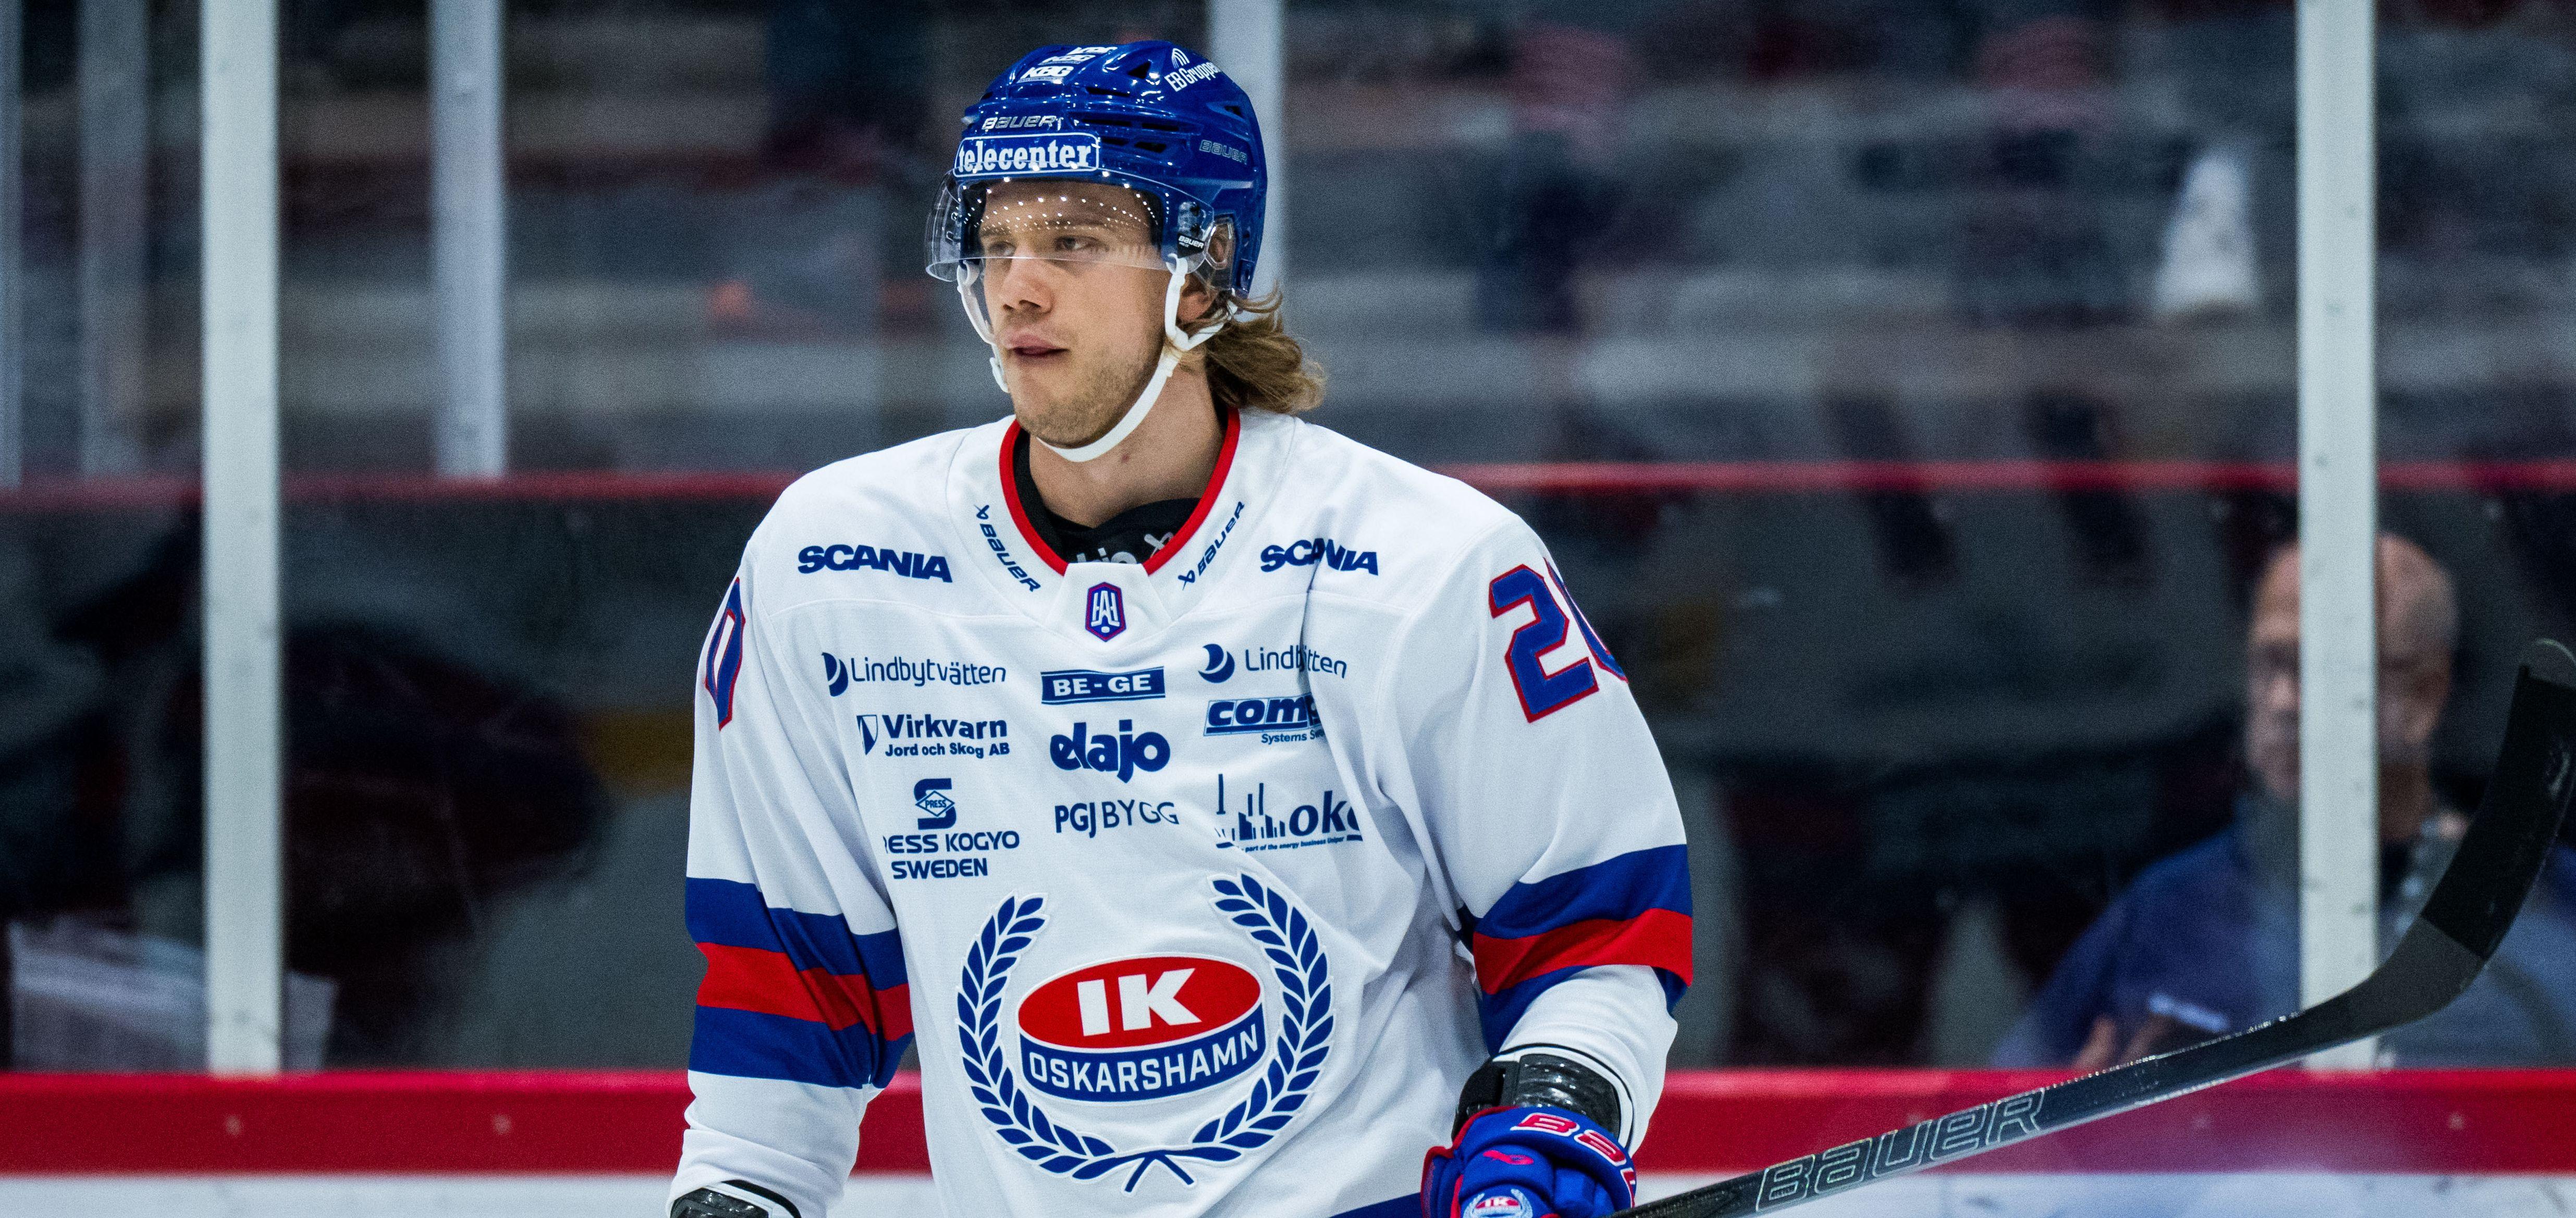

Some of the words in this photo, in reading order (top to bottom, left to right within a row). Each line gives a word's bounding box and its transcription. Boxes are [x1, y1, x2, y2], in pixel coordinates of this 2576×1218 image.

[1020, 66, 1074, 79] KBG
[1179, 62, 1220, 84] Gruppe
[982, 115, 1058, 130] BAUER
[959, 139, 1091, 173] telecenter
[1199, 139, 1247, 165] BAUER
[1179, 235, 1204, 249] BAUER
[1198, 501, 1244, 576] BAUER
[798, 544, 953, 583] SCANIA
[980, 523, 1041, 592] BAUER
[1260, 538, 1379, 576] SCANIA
[851, 656, 1006, 687] Lindbytvätten
[882, 714, 1007, 739] Virkvarn
[1261, 733, 1307, 745] Systems
[886, 744, 918, 756] Jord
[922, 743, 946, 756] och
[950, 742, 984, 759] Skog
[989, 742, 1010, 756] AB
[1050, 720, 1170, 783] elajo
[925, 799, 947, 809] PRESS
[1055, 802, 1097, 838] PGJ
[1101, 799, 1180, 829] BYGG
[883, 833, 939, 854] ESS
[945, 831, 1020, 852] KOGYO
[891, 858, 988, 879] SWEDEN
[1077, 968, 1202, 1037] IK
[1029, 1024, 1258, 1093] OSKARSHAMN
[1756, 1088, 2044, 1213] BAUER
